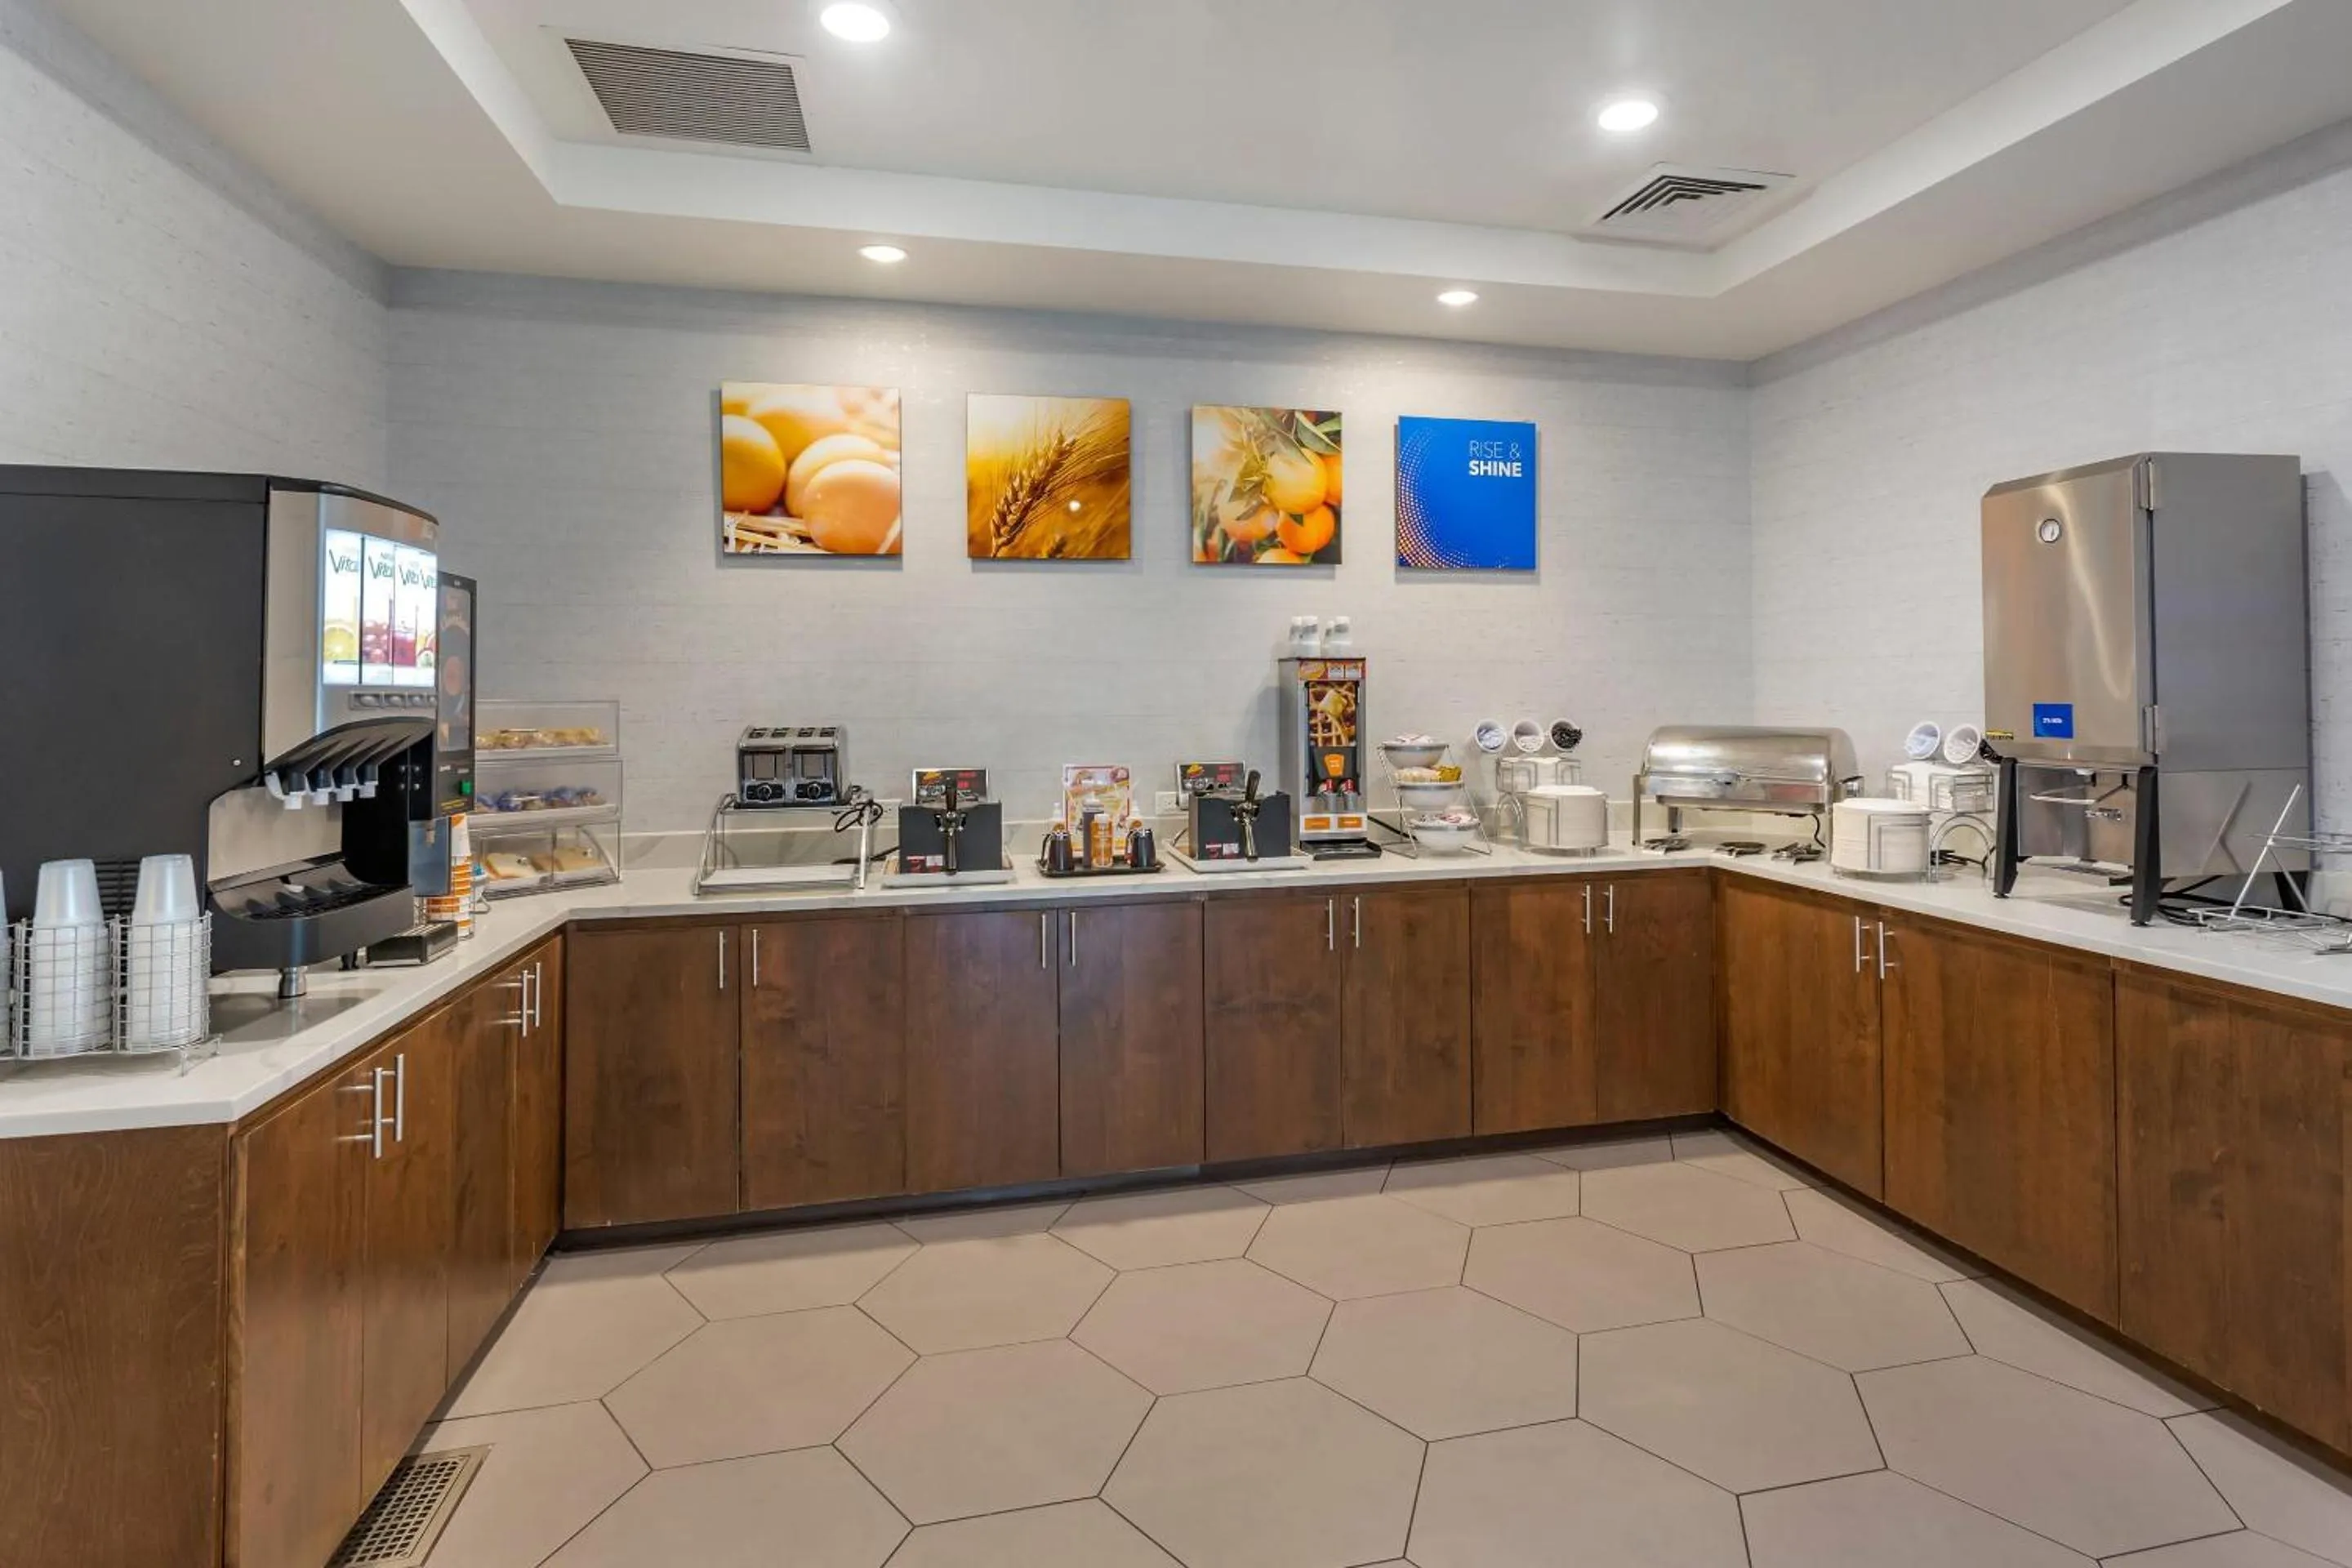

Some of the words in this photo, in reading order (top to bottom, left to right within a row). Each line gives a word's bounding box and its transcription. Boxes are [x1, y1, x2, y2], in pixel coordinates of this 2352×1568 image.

[1470, 440, 1503, 458] RISE
[1510, 442, 1521, 459] &
[1469, 460, 1522, 477] SHINE
